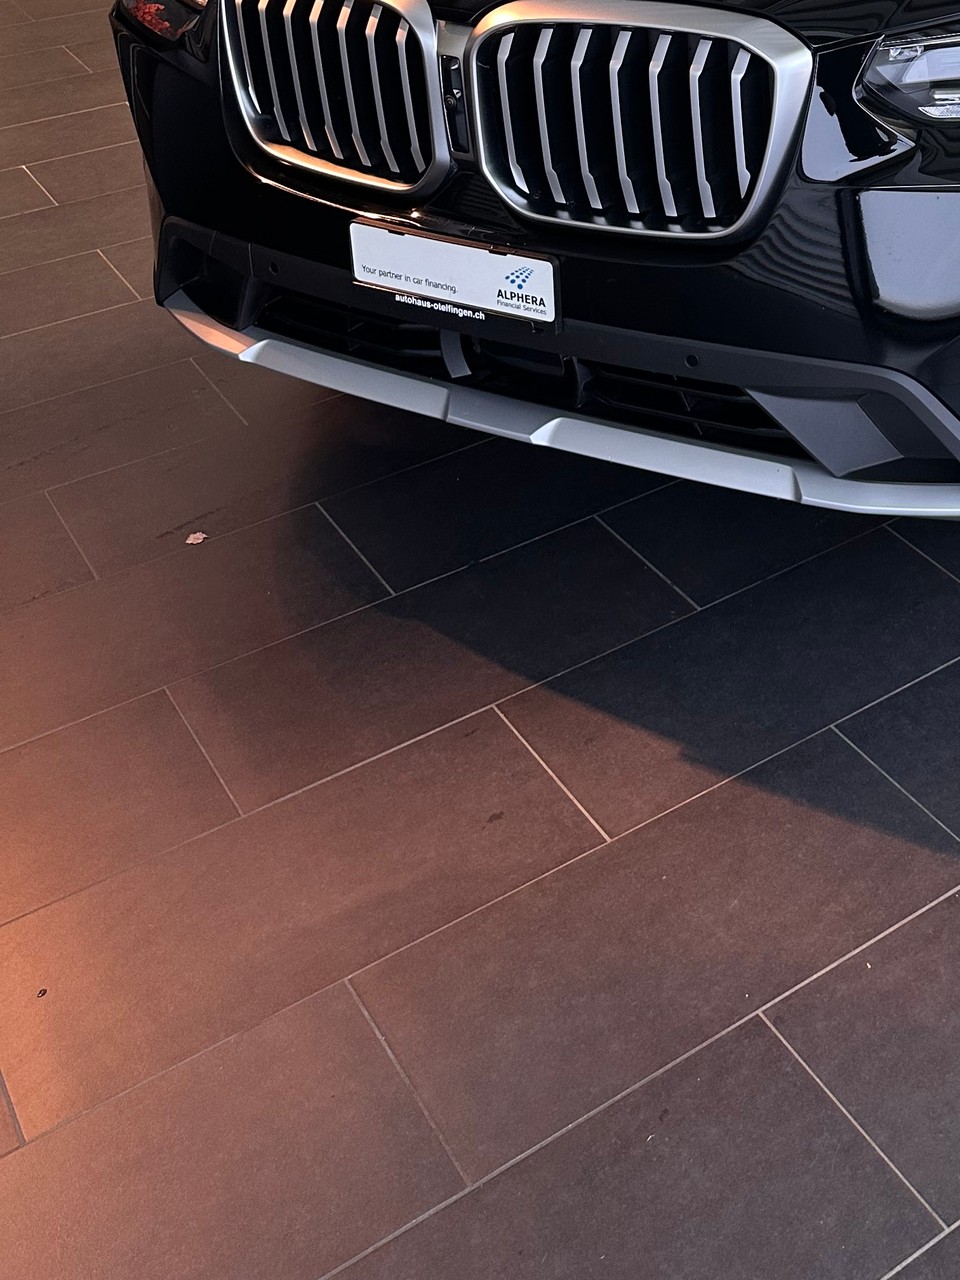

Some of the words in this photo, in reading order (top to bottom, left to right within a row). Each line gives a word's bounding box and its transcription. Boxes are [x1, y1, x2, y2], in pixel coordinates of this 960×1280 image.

[361, 264, 377, 275] Your
[378, 269, 403, 281] partner
[404, 274, 411, 282] in
[412, 277, 423, 285] car
[424, 278, 458, 294] financing.
[496, 288, 546, 308] ALPHERA
[496, 299, 521, 310] Financial
[522, 304, 547, 316] Services
